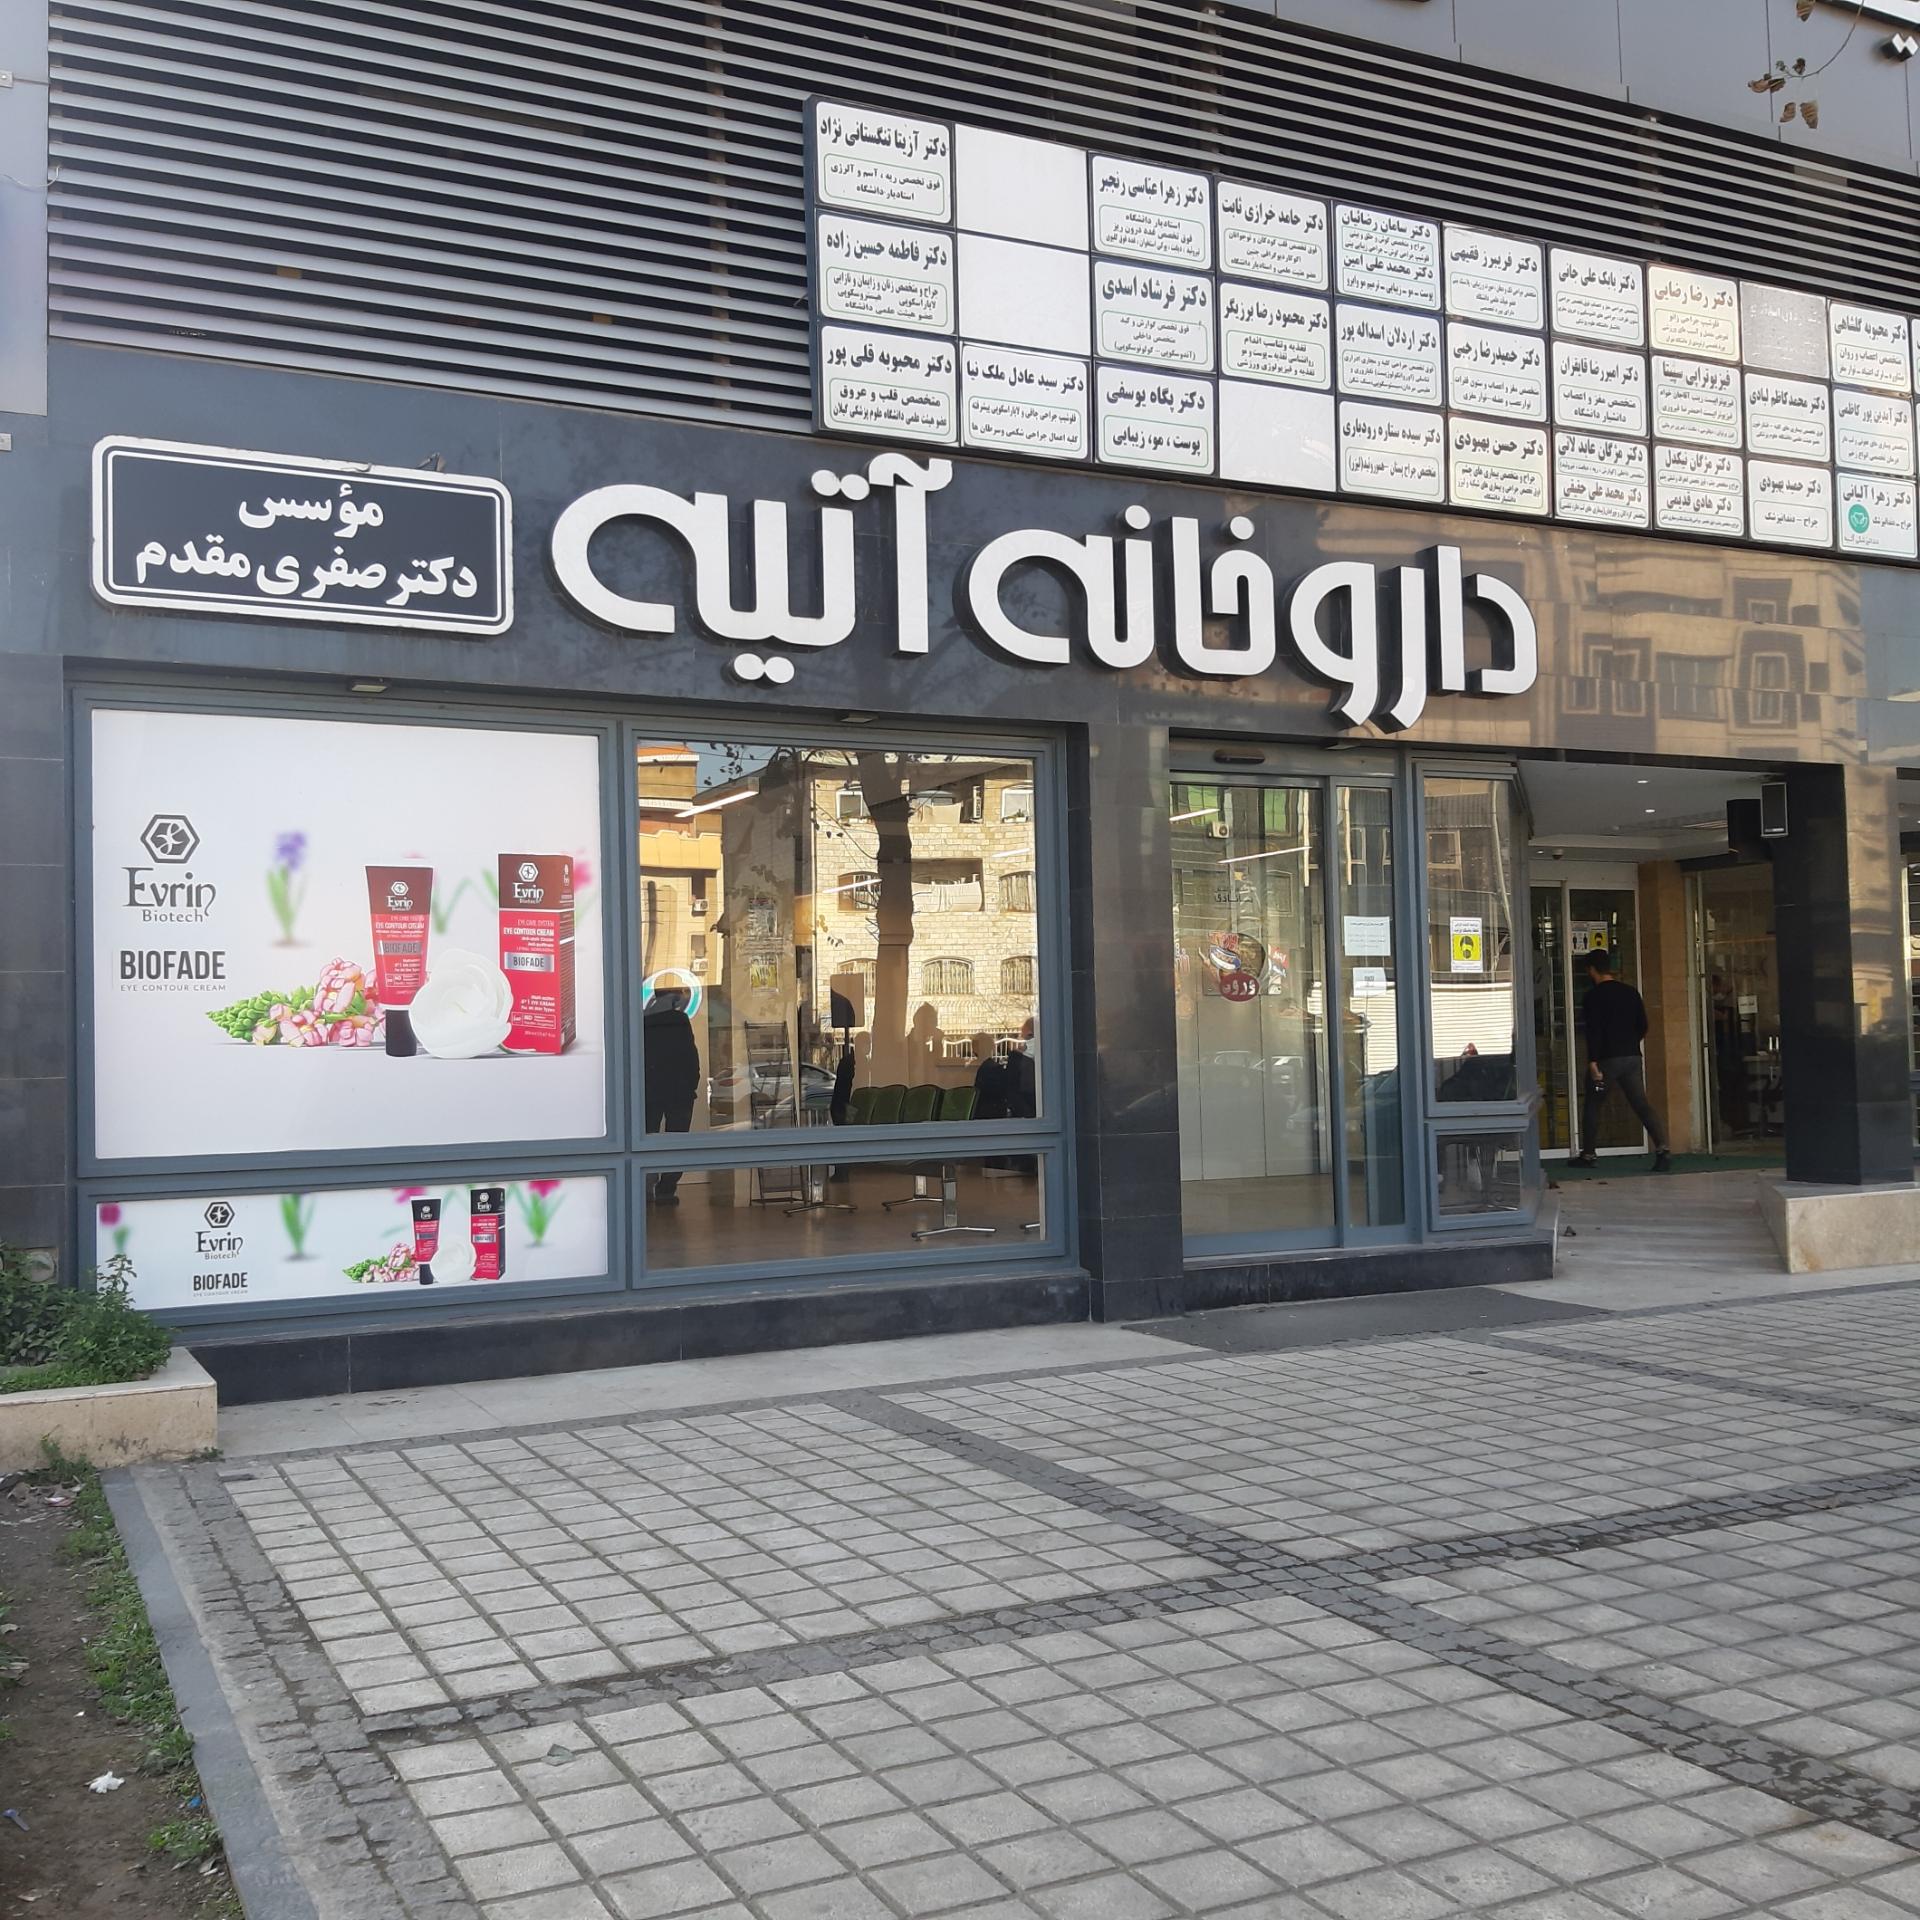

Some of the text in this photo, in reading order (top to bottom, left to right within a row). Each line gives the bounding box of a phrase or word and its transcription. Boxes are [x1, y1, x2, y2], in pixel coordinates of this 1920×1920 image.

[821, 116, 946, 160] دکتر آزیتا تنگستانی نژاد
[857, 184, 914, 200] استادیار دانشگاه
[1100, 171, 1125, 195] رنجبر
[1160, 180, 1180, 206] زهرا
[1184, 187, 1203, 207] دکتر
[1126, 213, 1180, 230] استادیار دانشگاه
[1222, 197, 1323, 233] دکتر حامد خرازی ثابت
[1381, 218, 1407, 232] سامان
[1410, 226, 1430, 238] دکتر
[827, 229, 946, 270] دکتر فاطمه حسین زاده
[1450, 244, 1537, 273] دکتر فریبرز فقیهی
[1344, 255, 1433, 280] دکتر محمد علی امین
[1559, 263, 1635, 292] دکتر بابک علی جانی
[1103, 276, 1206, 311] دکتر فرشاد اسدی
[1655, 281, 1733, 309] دکتر رضا رضایی
[1224, 298, 1253, 321] برزیگر
[1308, 313, 1327, 332] دکتر
[1865, 323, 1888, 340] محبوبه
[1341, 325, 1354, 342] پور
[1387, 326, 1415, 349] اردلان
[1418, 332, 1436, 351] دکتر
[1891, 325, 1906, 343] دکتر
[827, 344, 951, 377] دکتر محبوبه قلی پور
[1454, 342, 1477, 361] رجبی
[1521, 348, 1540, 369] دکتر
[1840, 348, 1853, 359] روان
[1860, 351, 1877, 360] اعصاب
[967, 360, 1084, 394] دکتر سید عادل ملک نیا
[1621, 366, 1638, 384] دکتر
[1686, 366, 1730, 390] فیزیوتراپی
[840, 385, 940, 406] متخصص قلب و عروق
[1107, 381, 1205, 413] دکتر پگاه یوسفی
[1563, 390, 1585, 400] اعصاب
[1594, 395, 1605, 405] مغز
[1608, 399, 1636, 408] متخصص
[1771, 390, 1788, 406] کاظم
[1789, 397, 1807, 407] محمد
[1810, 397, 1825, 413] دکتر
[1839, 402, 1860, 417] کاظمی
[1575, 408, 1626, 422] دانشیار دانشگاه
[1894, 411, 1907, 426] دکتر
[1113, 426, 1145, 448] زیبایی
[1343, 418, 1440, 446] دکتر سیده ستاره رودباری
[1173, 436, 1200, 456] پوست
[1455, 433, 1543, 459] دکتر حسن بهبودی
[1579, 439, 1595, 457] عابد
[1599, 442, 1622, 463] مژگان
[1626, 447, 1643, 465] دکتر
[1690, 453, 1712, 473] مژگان
[1715, 458, 1731, 474] دکتر
[1589, 481, 1602, 500] علی
[1605, 487, 1624, 499] محمد
[1627, 488, 1642, 505] دکتر
[1786, 480, 1803, 494] حمید
[1807, 480, 1821, 497] دکتر
[1693, 494, 1712, 511] هادی
[1716, 497, 1731, 514] دکتر
[1871, 488, 1889, 506] زهرا
[1893, 492, 1910, 507] دکتر
[239, 483, 383, 538] مؤسس
[136, 533, 477, 605] دکتر صفری مقدم
[550, 453, 1540, 729] داروخانه آتیه
[122, 867, 216, 916] Evrin
[142, 909, 203, 922] Biotech
[120, 950, 225, 979] BIOFADE
[513, 956, 544, 967] BIOFADE
[195, 1231, 243, 1255] Evrin
[205, 1251, 236, 1260] Biotech
[193, 1272, 248, 1291] BIOFADE
